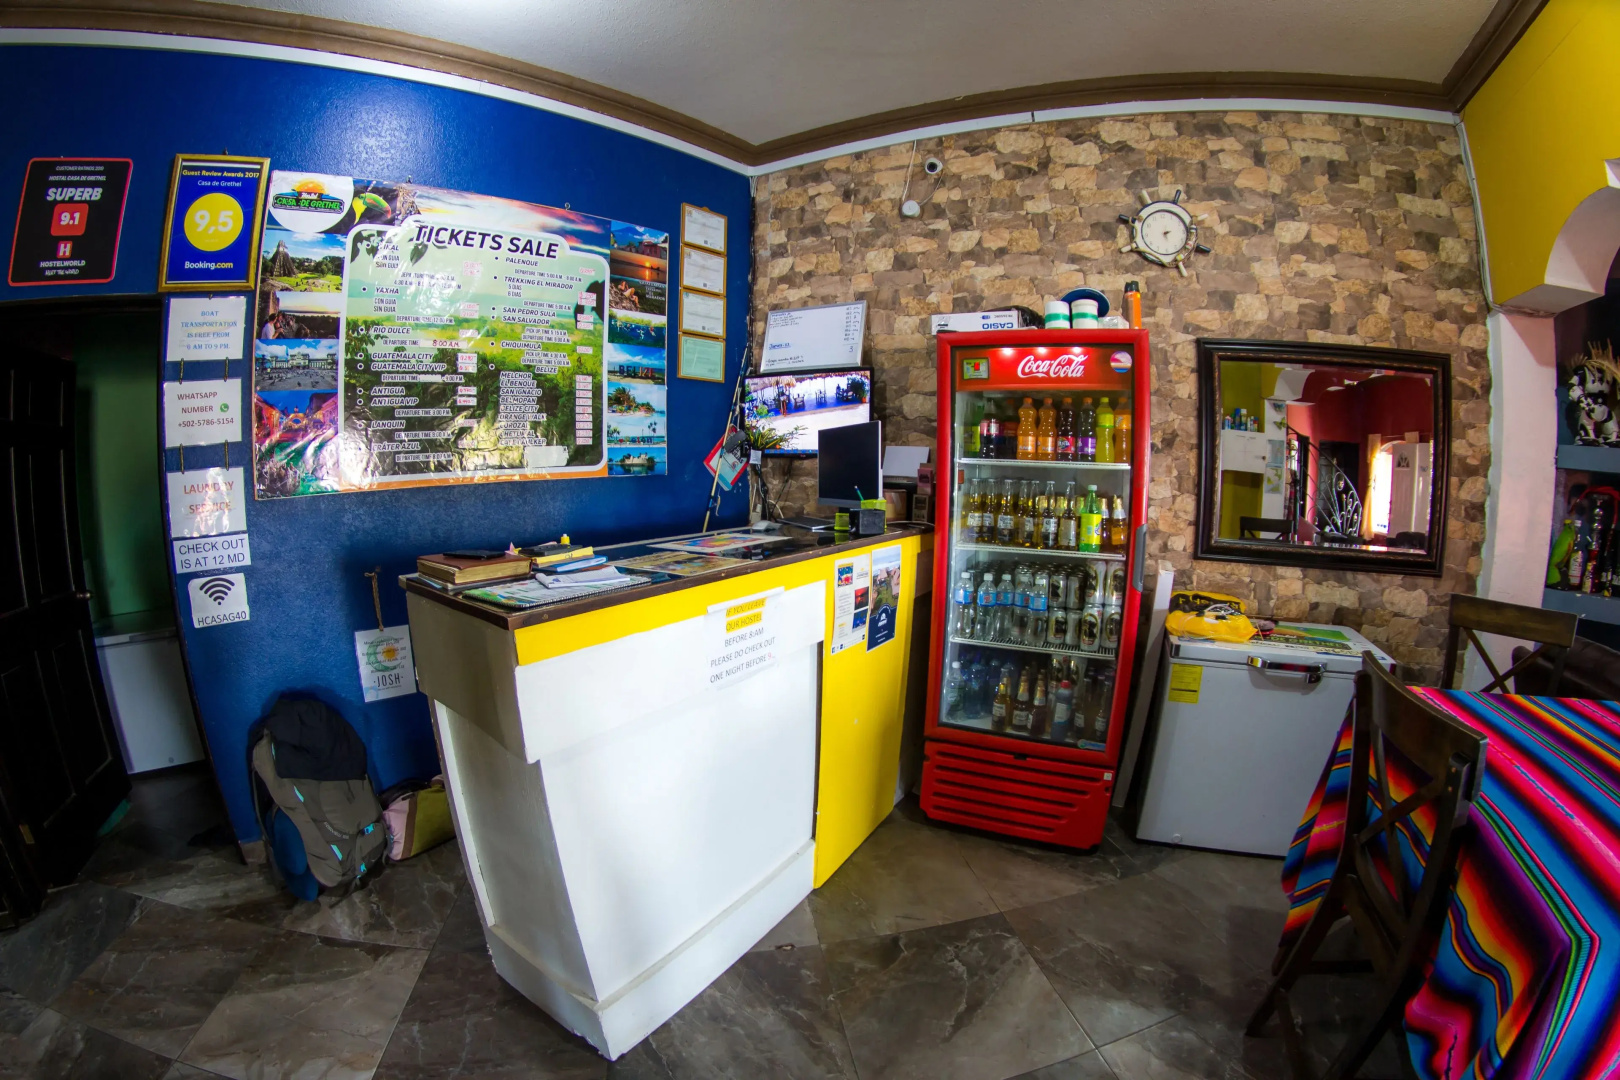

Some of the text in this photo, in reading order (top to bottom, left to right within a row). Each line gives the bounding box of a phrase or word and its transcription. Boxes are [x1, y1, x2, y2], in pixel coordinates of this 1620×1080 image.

[46, 187, 103, 201] SUPERB
[310, 202, 340, 210] GRETHEL
[60, 212, 80, 226] 9.1
[194, 210, 234, 234] 9,5
[414, 225, 559, 259] TICKETS SALE
[60, 244, 70, 256] H
[184, 260, 234, 270] Booking.com
[506, 258, 538, 266] PALENQUE
[504, 276, 536, 285] TREKKING
[546, 281, 574, 290] MIRADOR
[517, 316, 550, 325] SALVADOR
[1017, 354, 1088, 378] Coca-Cola
[177, 392, 218, 400] WHATSAPP
[182, 405, 214, 414] NUMBER
[178, 418, 234, 428] +502-5786-5154
[178, 538, 245, 555] CHECK OUT
[180, 552, 245, 569] IS AT 12 MD
[733, 604, 746, 615] YOU
[747, 599, 765, 610] LEAVE
[198, 611, 246, 626] HCASAG40
[726, 614, 762, 632] OUR HOSTEL
[724, 633, 748, 648] BEFORE
[710, 636, 776, 668] PLEASE DO CHECK OUT
[710, 654, 766, 684] ONE NIGHT BEFORE
[377, 672, 400, 688] JOSH
